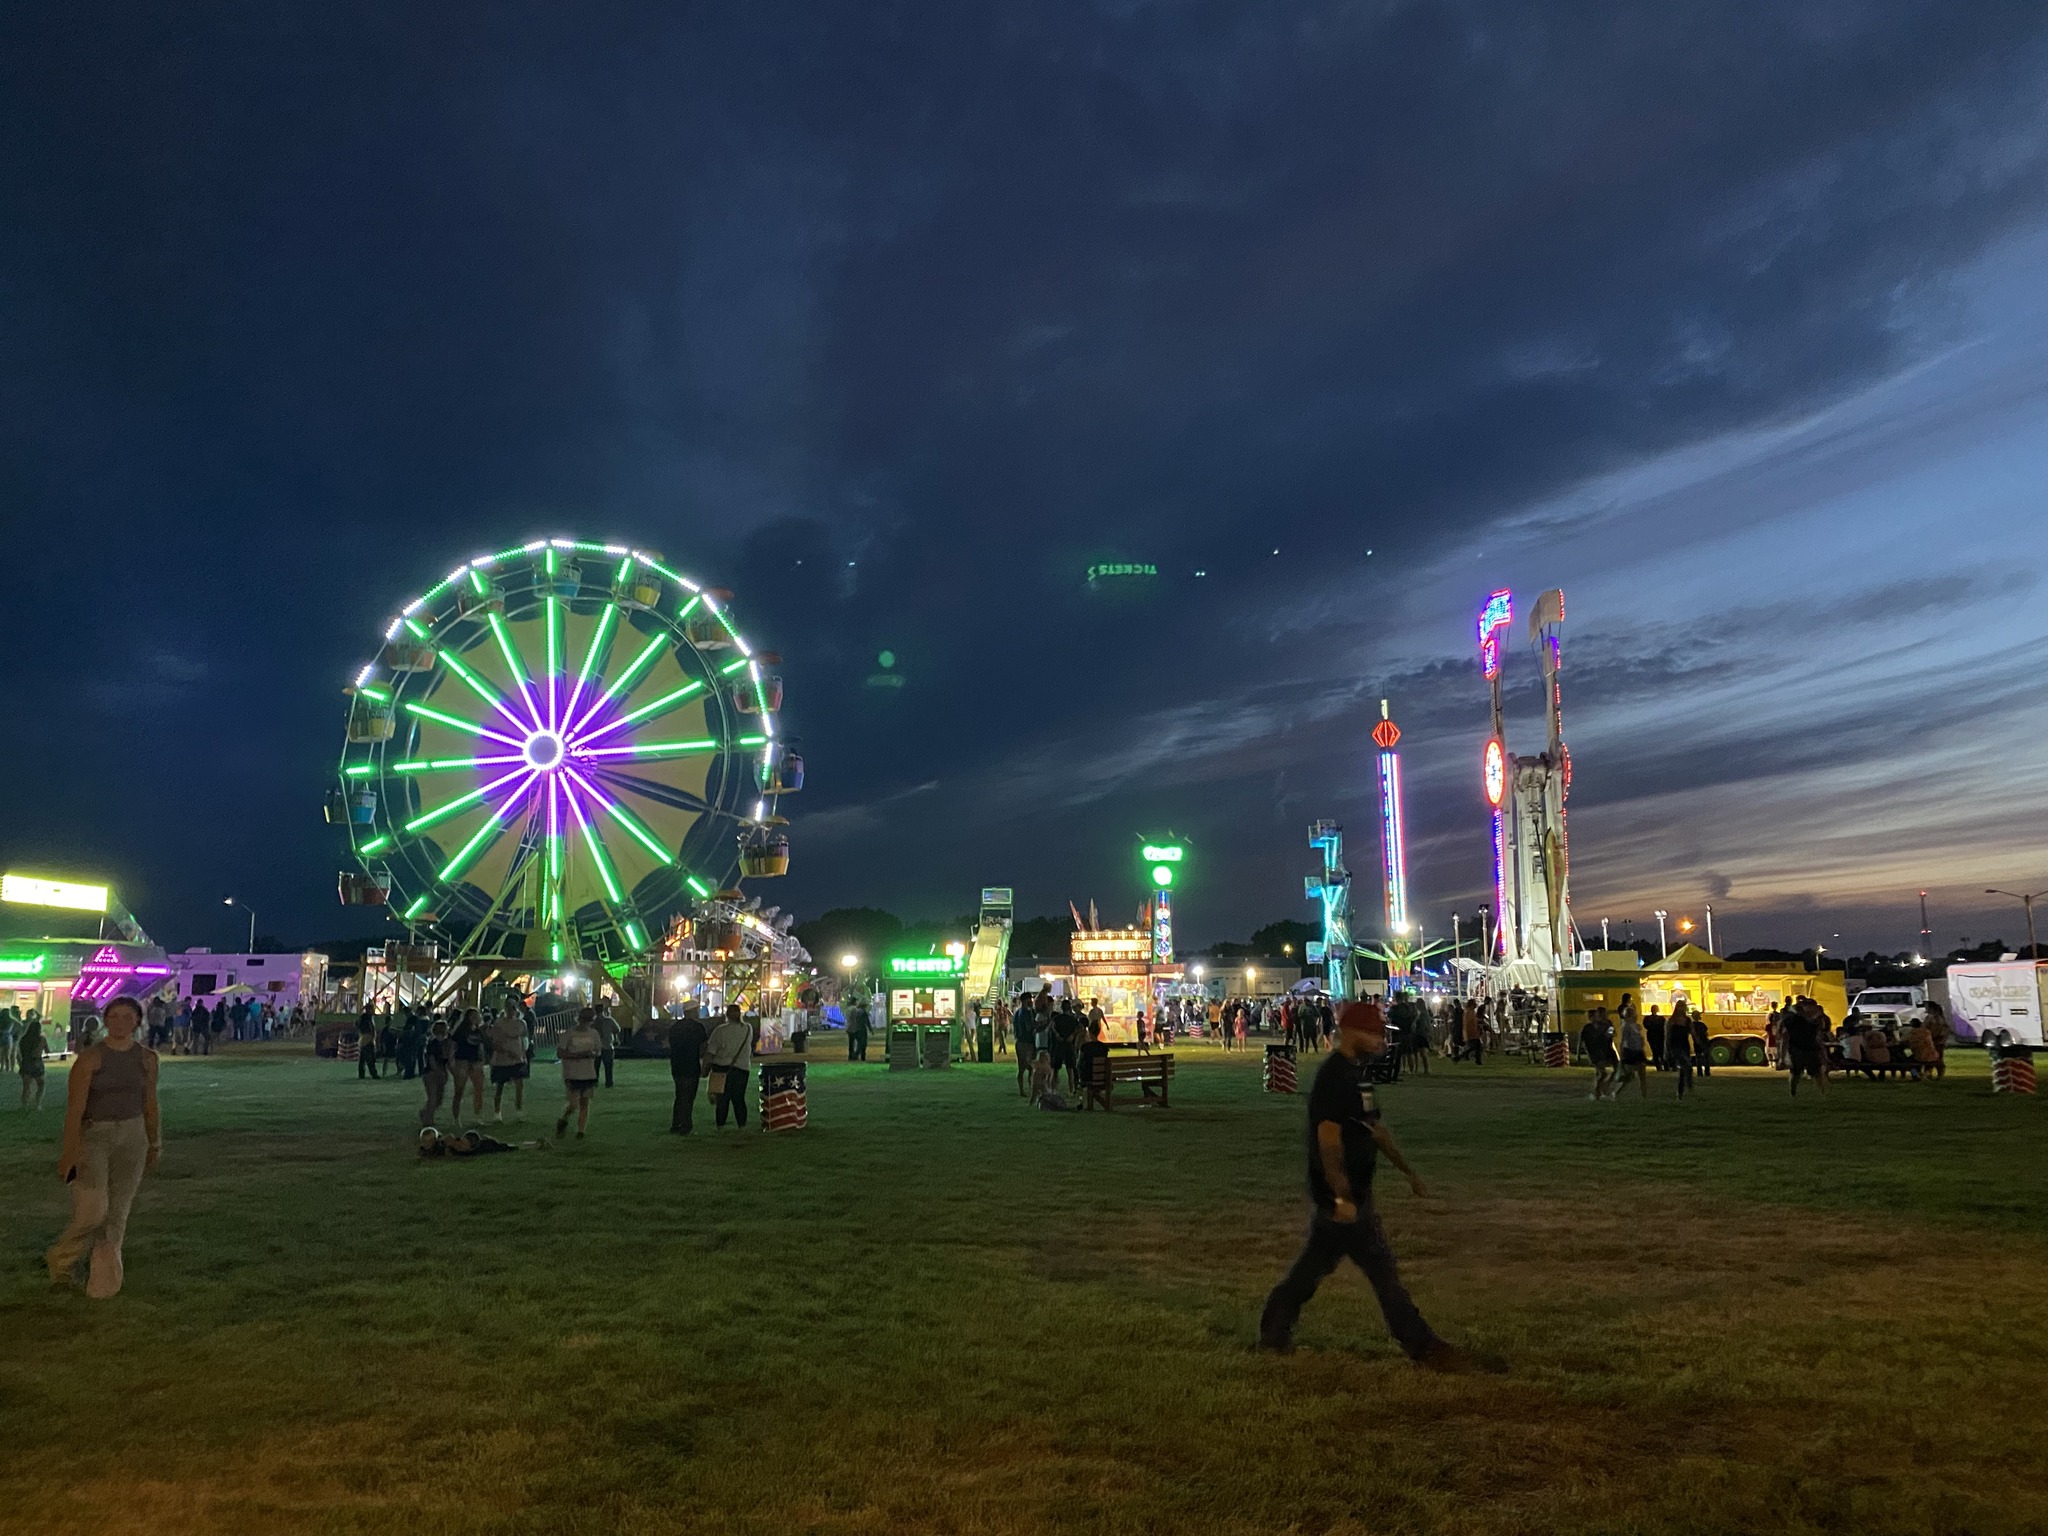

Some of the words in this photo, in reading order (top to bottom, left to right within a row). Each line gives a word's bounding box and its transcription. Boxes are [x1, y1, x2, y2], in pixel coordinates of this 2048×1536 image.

[1099, 564, 1157, 575] TICKETS
[891, 958, 952, 972] TICKETS
[1077, 966, 1116, 974] CARAMEL
[1118, 965, 1146, 974] APPLES
